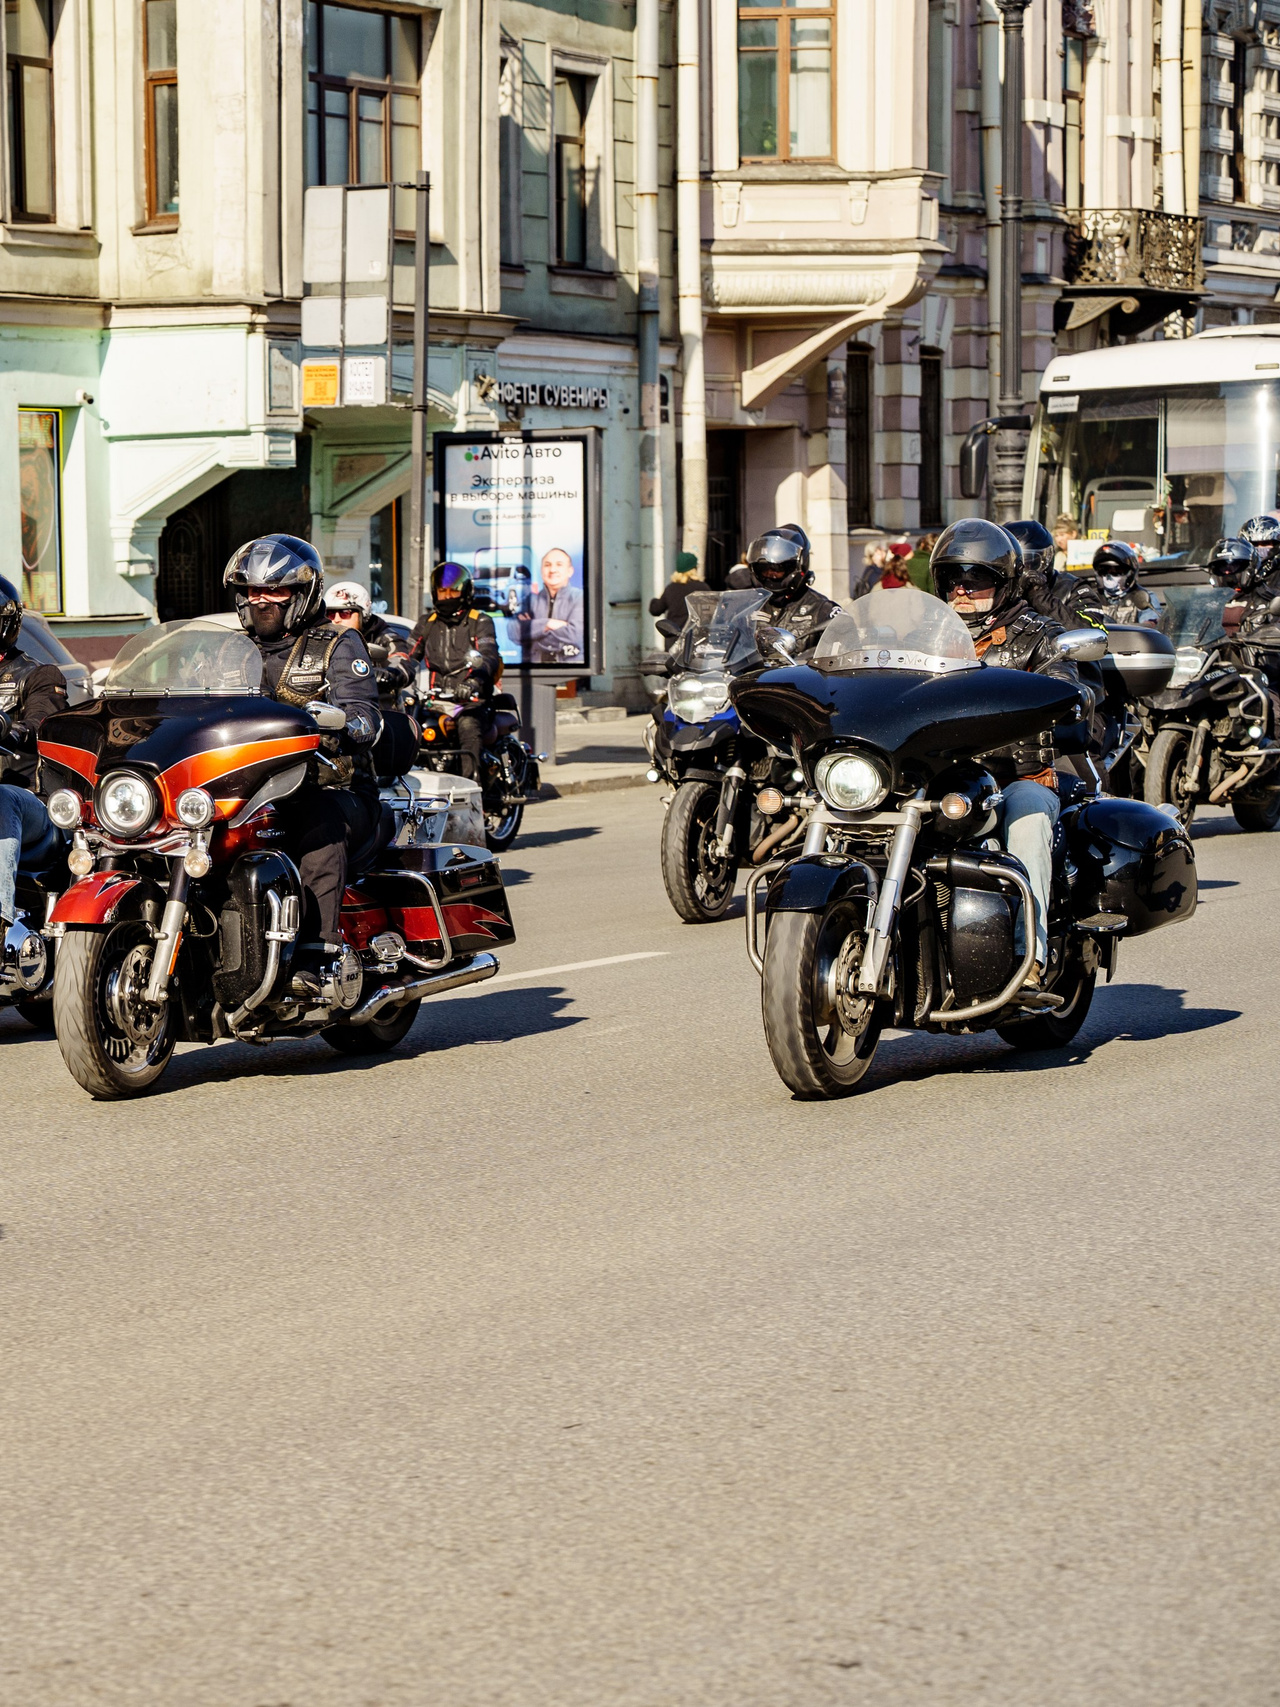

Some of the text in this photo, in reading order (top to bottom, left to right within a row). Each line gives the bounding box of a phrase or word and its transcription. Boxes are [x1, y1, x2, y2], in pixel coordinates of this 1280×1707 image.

[544, 384, 611, 409] СУВЕНИРЫ
[480, 444, 563, 461] Avito Авто
[471, 474, 556, 488] Экспертиза
[461, 490, 515, 504] выборе
[517, 489, 578, 501] машины
